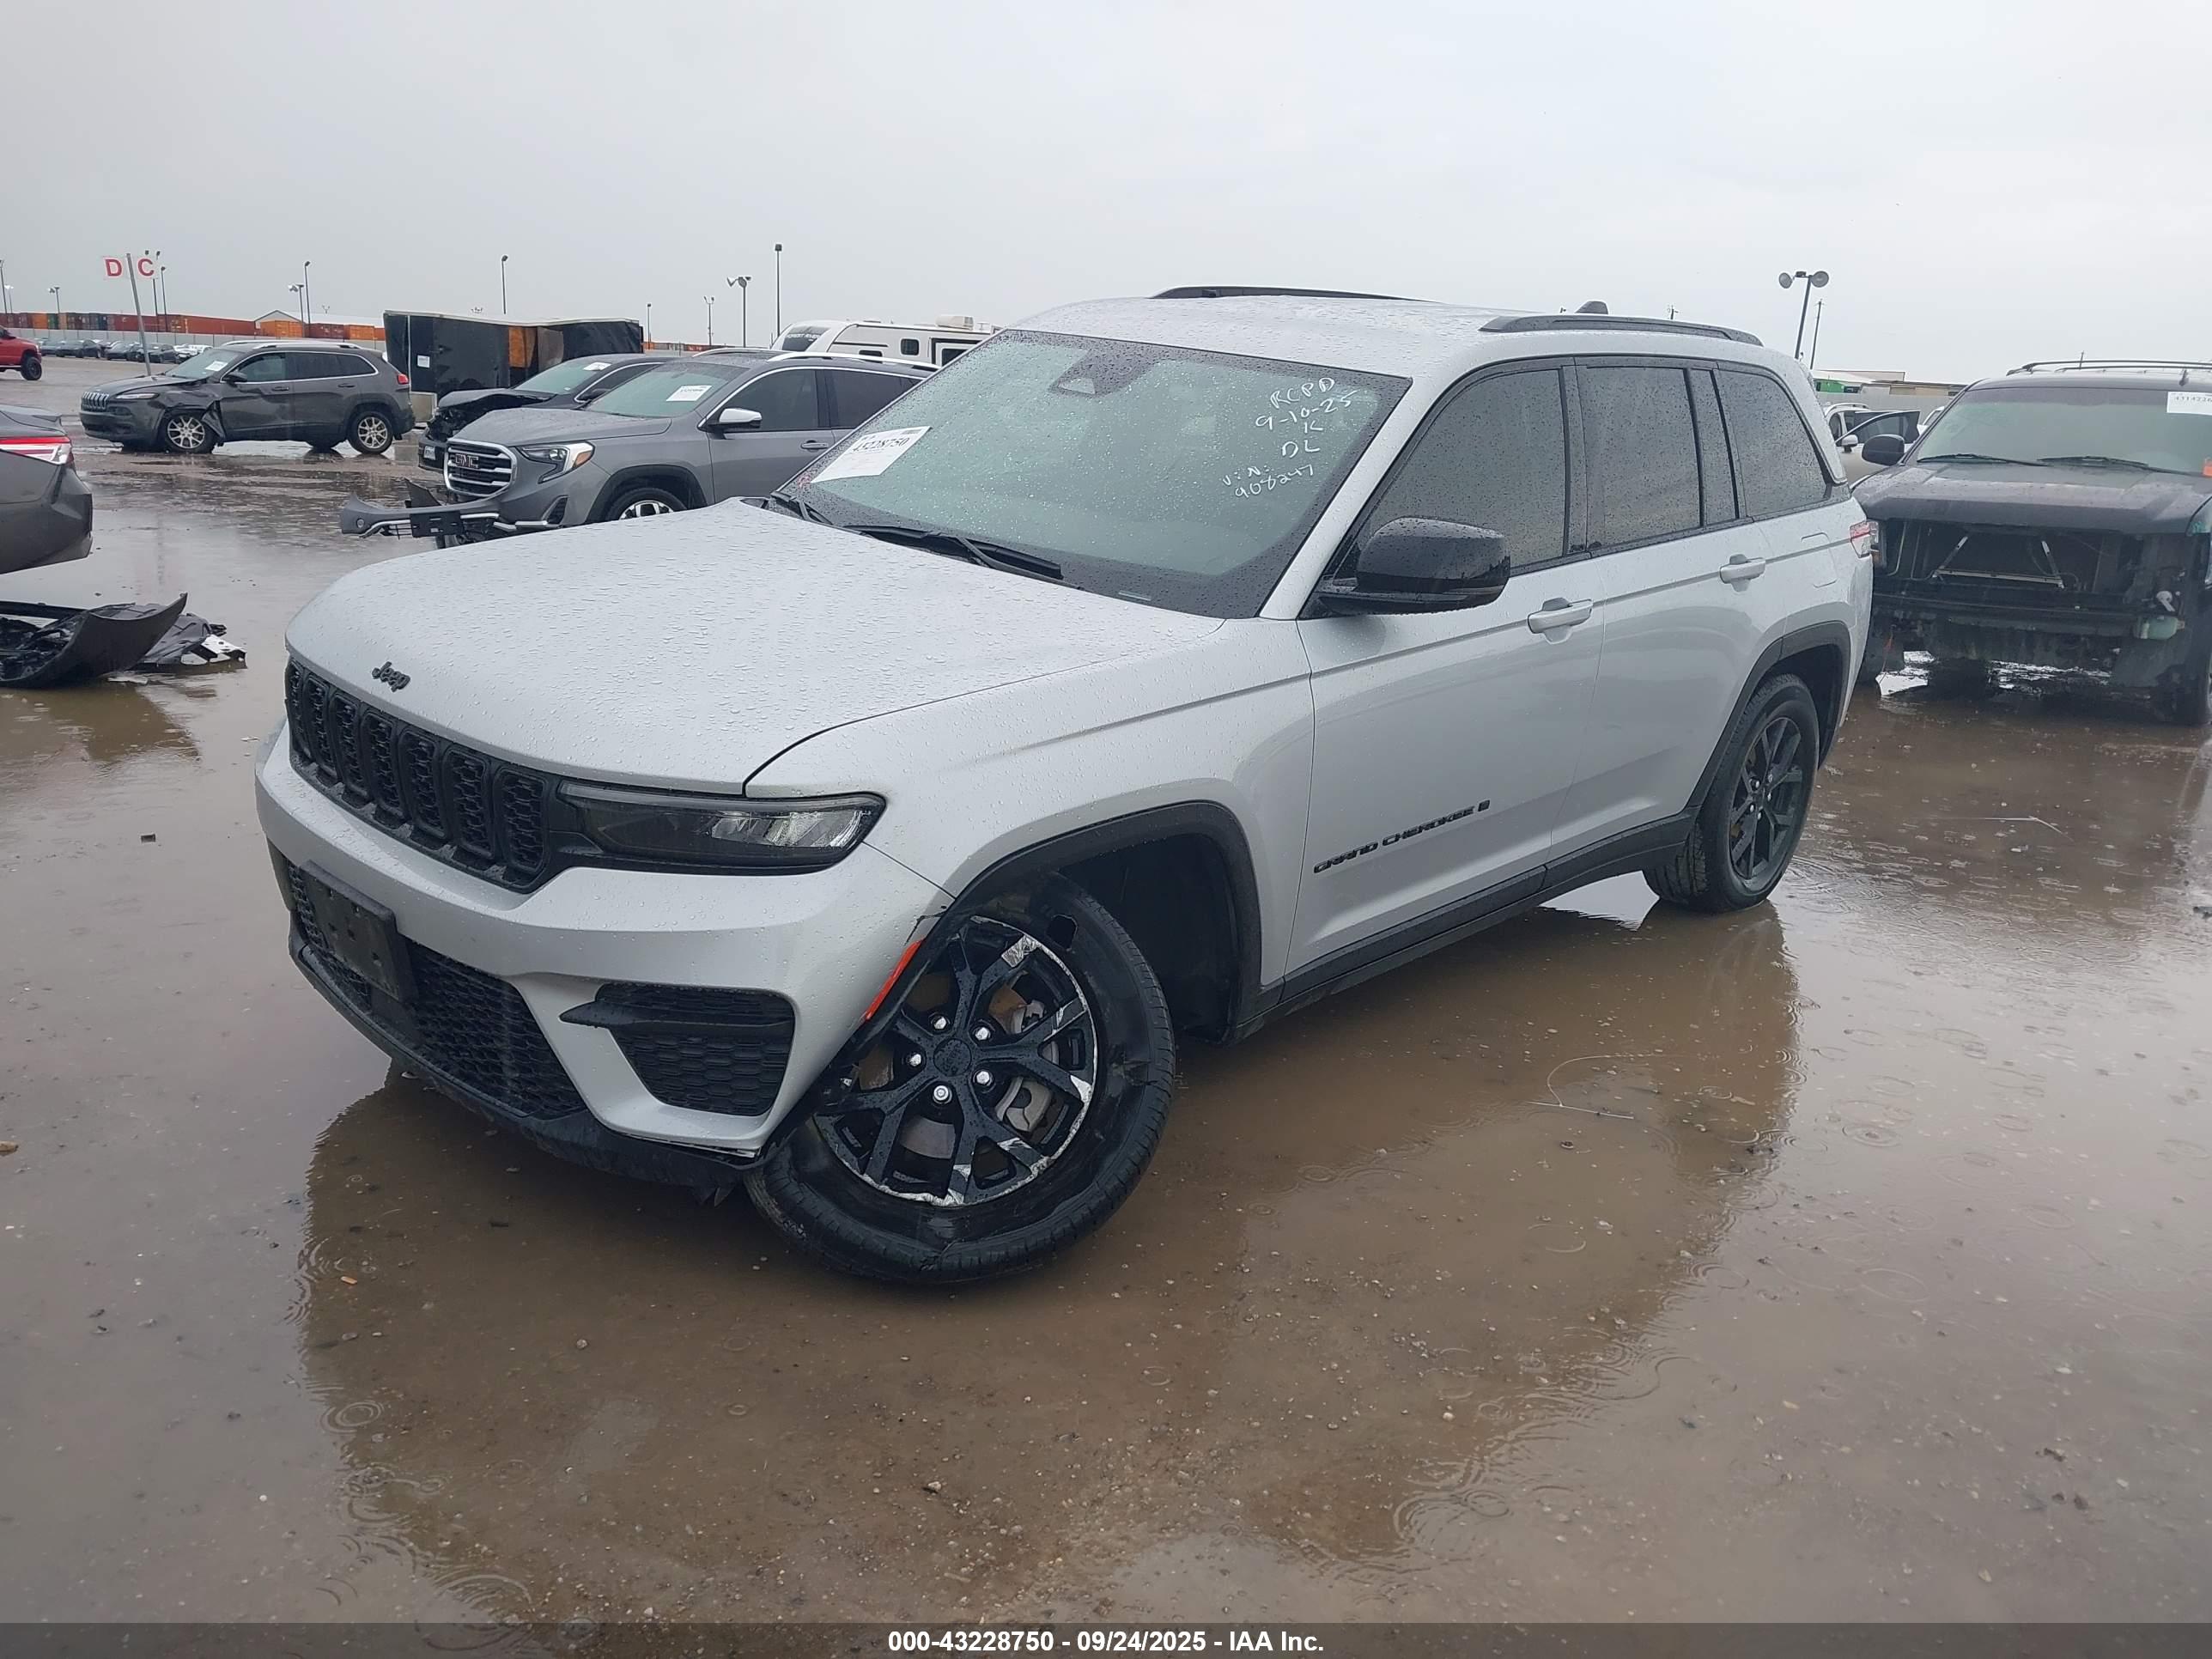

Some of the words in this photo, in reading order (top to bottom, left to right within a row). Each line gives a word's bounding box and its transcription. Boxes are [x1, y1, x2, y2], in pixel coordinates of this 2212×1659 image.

[105, 258, 122, 276] D
[137, 258, 155, 276] C
[1255, 389, 1360, 430] 9-10-25
[455, 453, 479, 468] GMC
[371, 660, 411, 693] Jeep
[1313, 841, 1378, 873] GRAND
[1382, 805, 1475, 847] CHEROKEE
